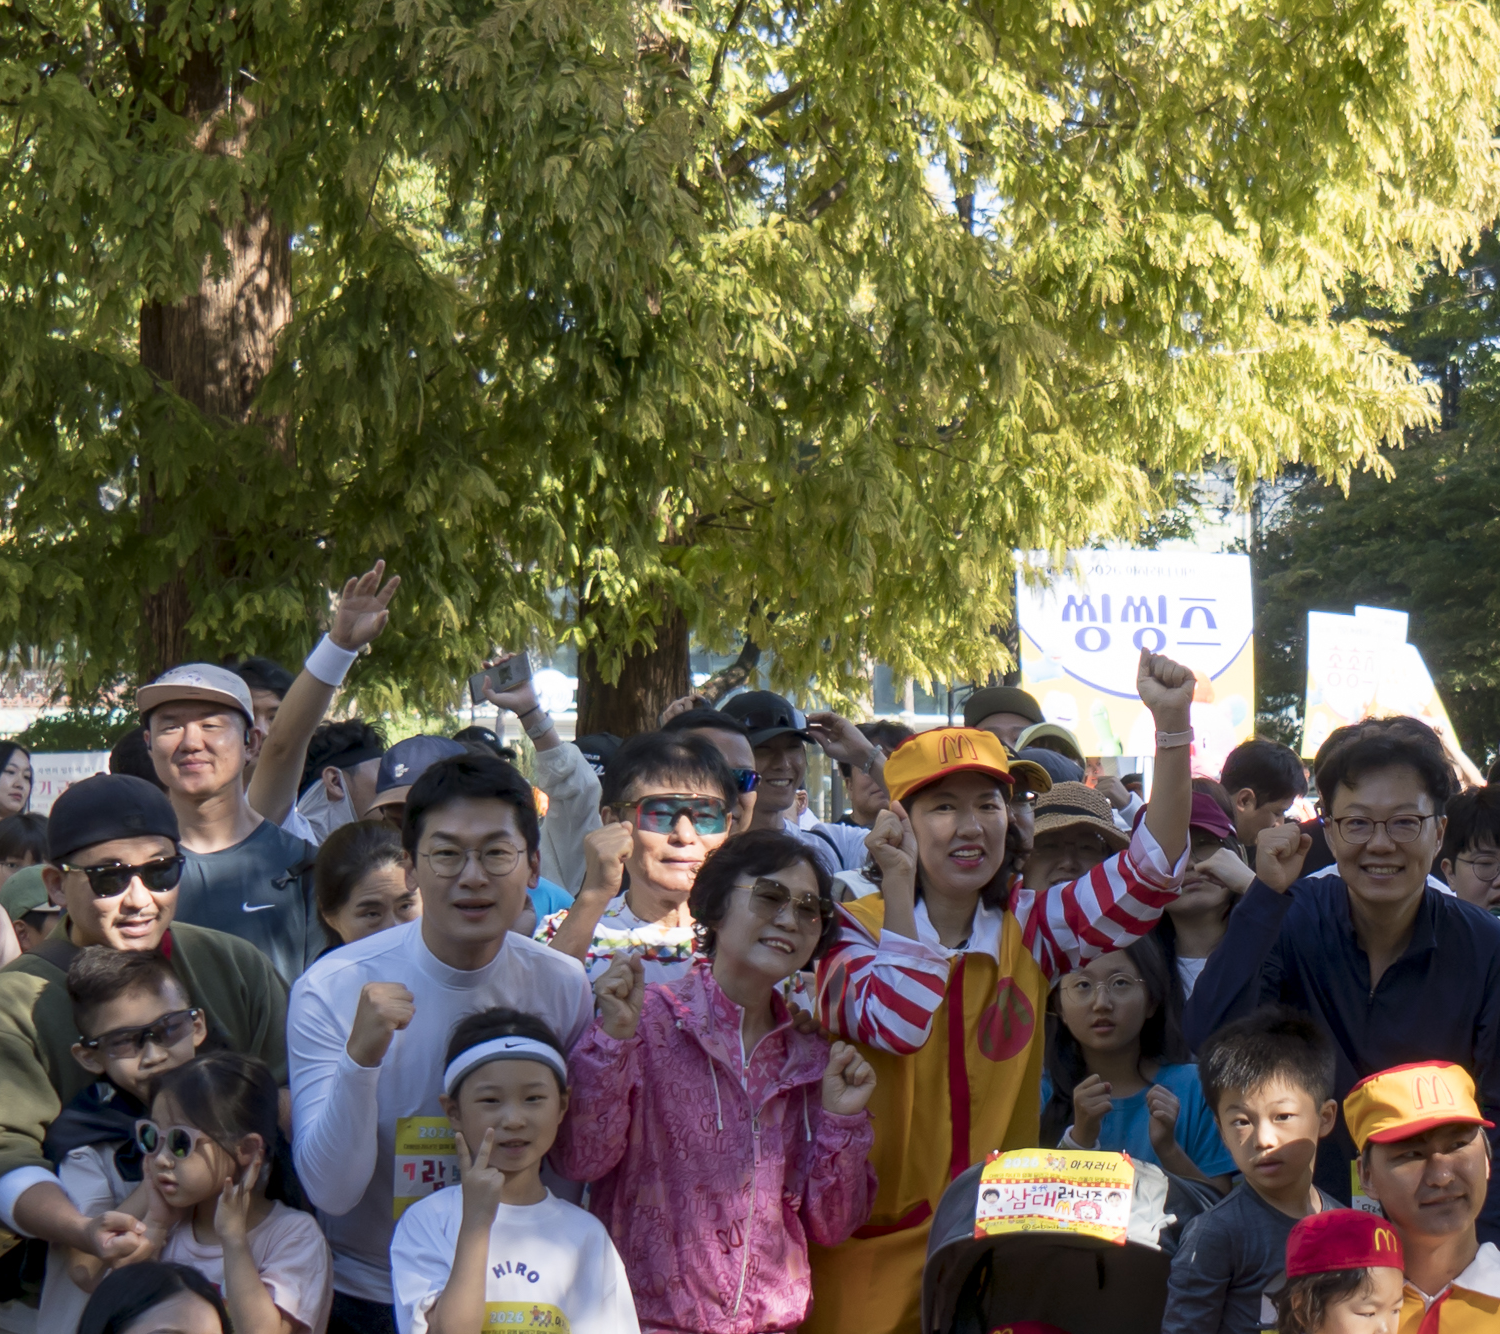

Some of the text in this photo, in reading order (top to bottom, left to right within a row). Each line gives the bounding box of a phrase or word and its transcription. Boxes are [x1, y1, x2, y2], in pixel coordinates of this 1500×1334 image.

[1061, 593, 1221, 654] 씽씽즈
[1004, 1156, 1118, 1172] 2026 아자러너
[1007, 1186, 1103, 1210] 삼대 러너즈
[492, 1261, 541, 1285] HIRO
[489, 1310, 525, 1324] 2026
